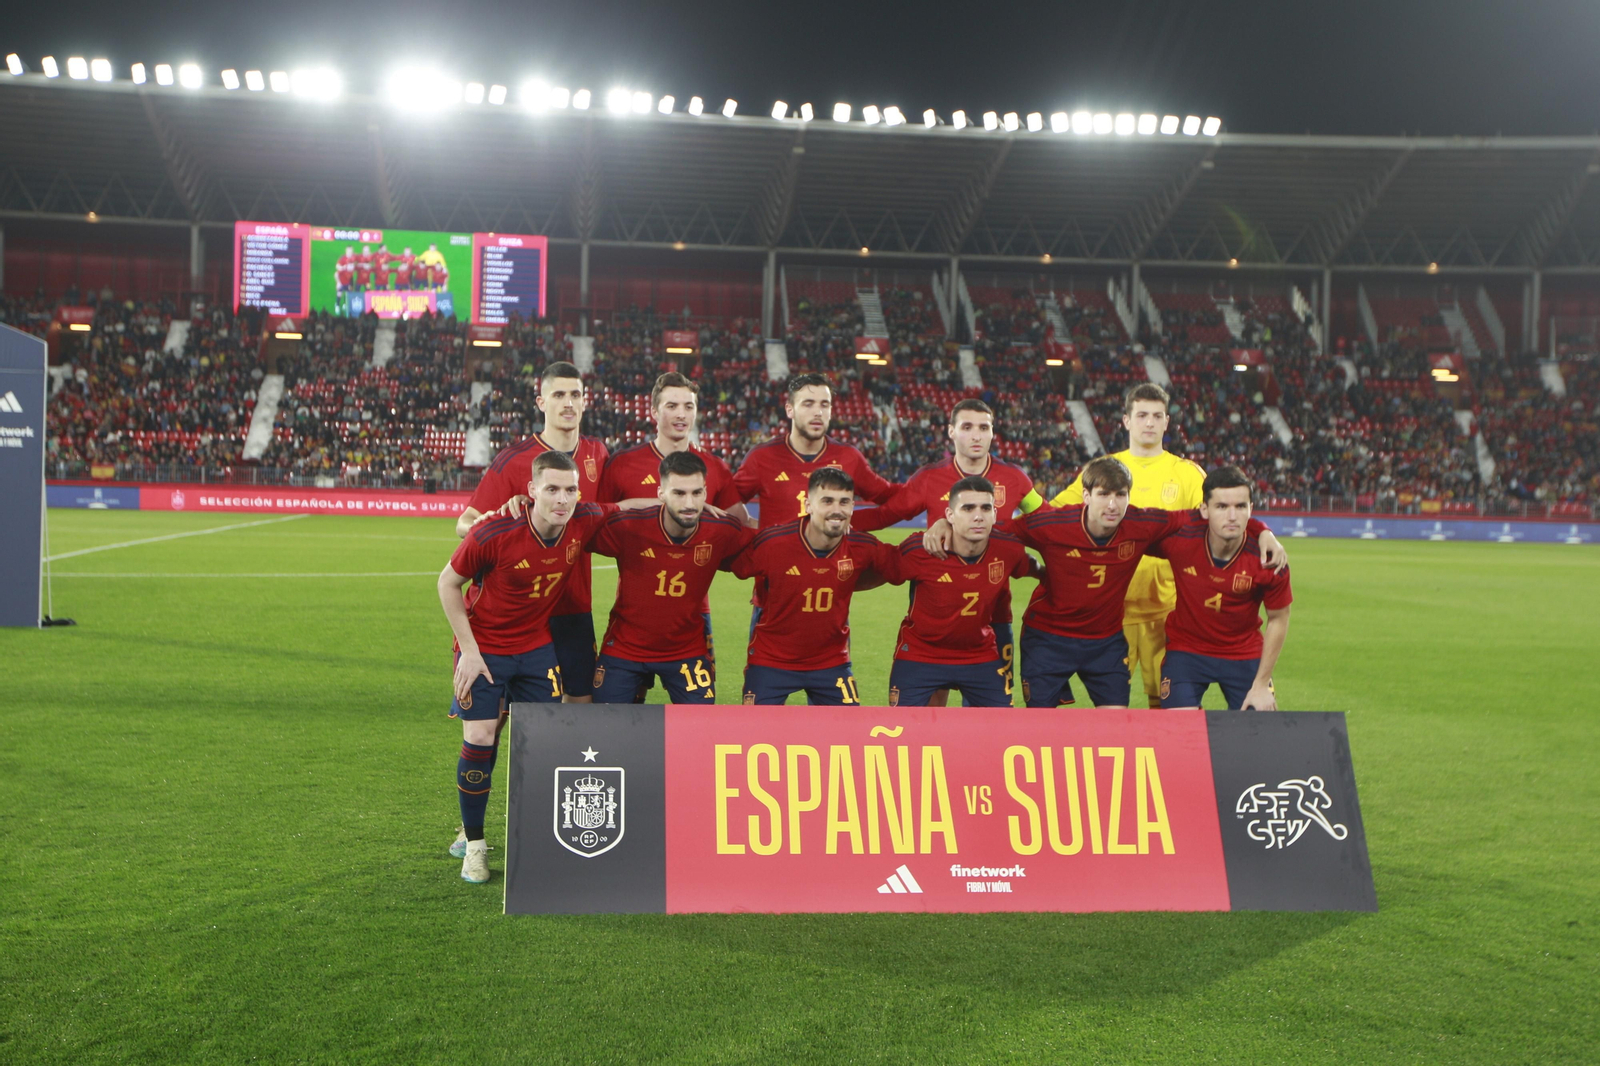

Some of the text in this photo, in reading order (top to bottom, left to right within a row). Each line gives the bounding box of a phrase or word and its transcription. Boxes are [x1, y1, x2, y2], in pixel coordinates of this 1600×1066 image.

[199, 496, 464, 511] SELECCIÓN ESPAÑOLA DE FÚTBOL SUB-21
[796, 490, 809, 517] 1
[529, 572, 563, 598] 17
[654, 570, 687, 597] 16
[1087, 565, 1107, 588] 3
[802, 587, 833, 612] 10
[960, 592, 980, 616] 2
[1204, 592, 1223, 612] 4
[680, 659, 712, 692] 16
[714, 725, 1176, 856] ESPAÑA VS SUIZA
[950, 864, 1026, 877] finetwork
[966, 880, 1013, 893] FIBRA Y MÓVIL
